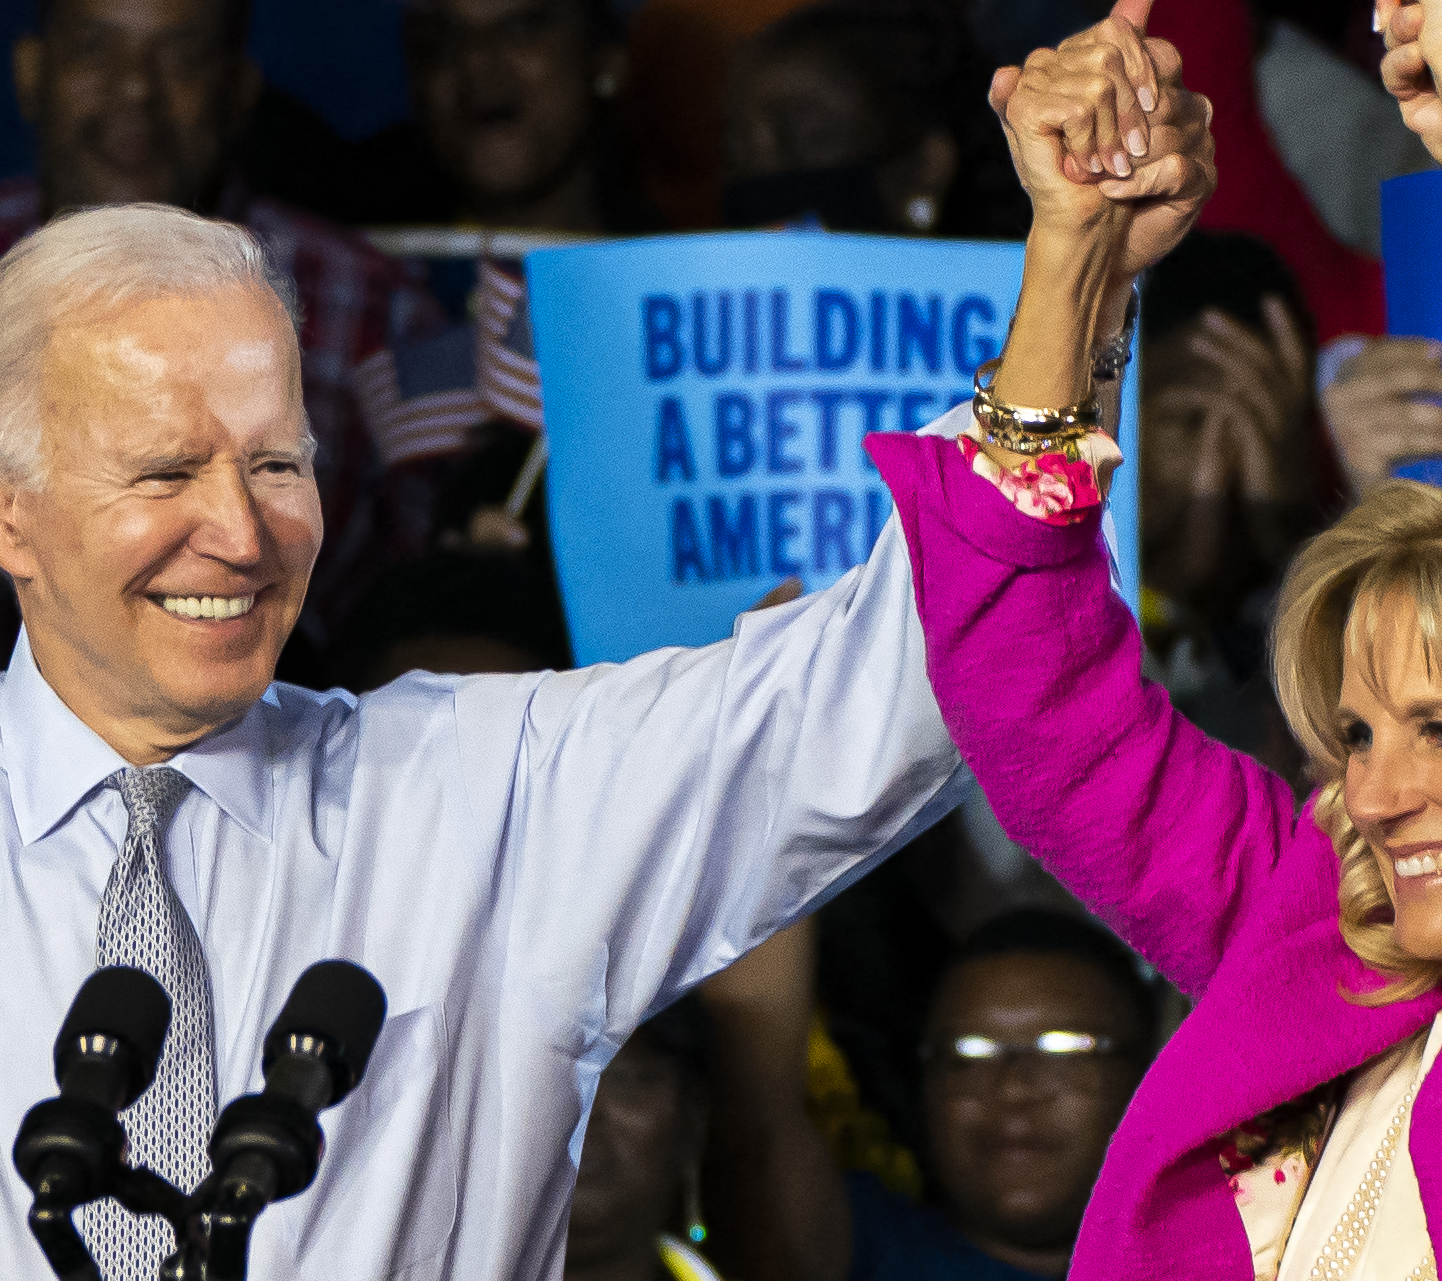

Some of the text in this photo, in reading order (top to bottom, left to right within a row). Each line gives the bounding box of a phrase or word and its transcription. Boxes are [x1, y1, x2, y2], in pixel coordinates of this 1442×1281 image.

[642, 285, 1000, 384] BUILDING
[652, 388, 975, 485] A BETTE
